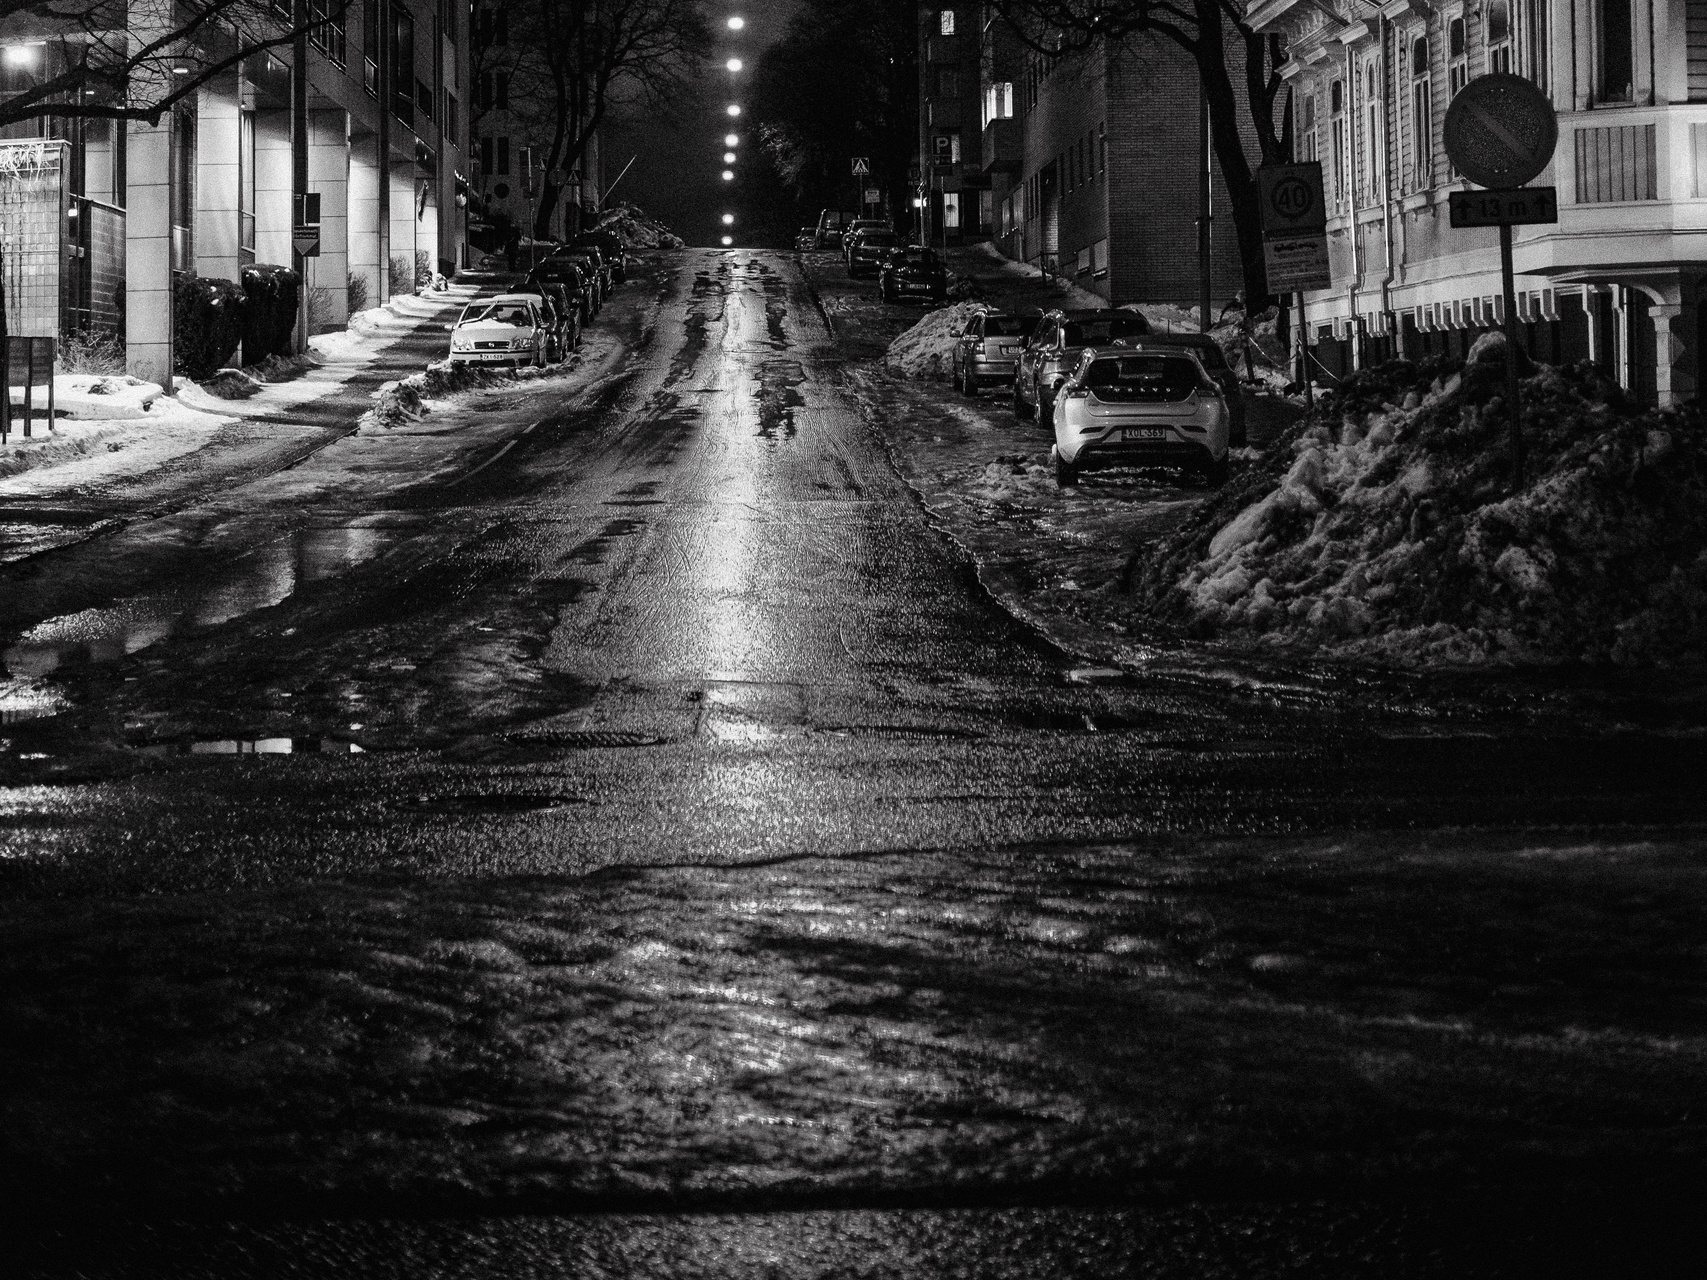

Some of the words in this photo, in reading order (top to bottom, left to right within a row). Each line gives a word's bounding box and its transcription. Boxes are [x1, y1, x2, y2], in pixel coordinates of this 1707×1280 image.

[936, 137, 949, 154] P
[1278, 185, 1306, 209] 40
[1479, 198, 1500, 218] 13
[1508, 201, 1526, 216] m
